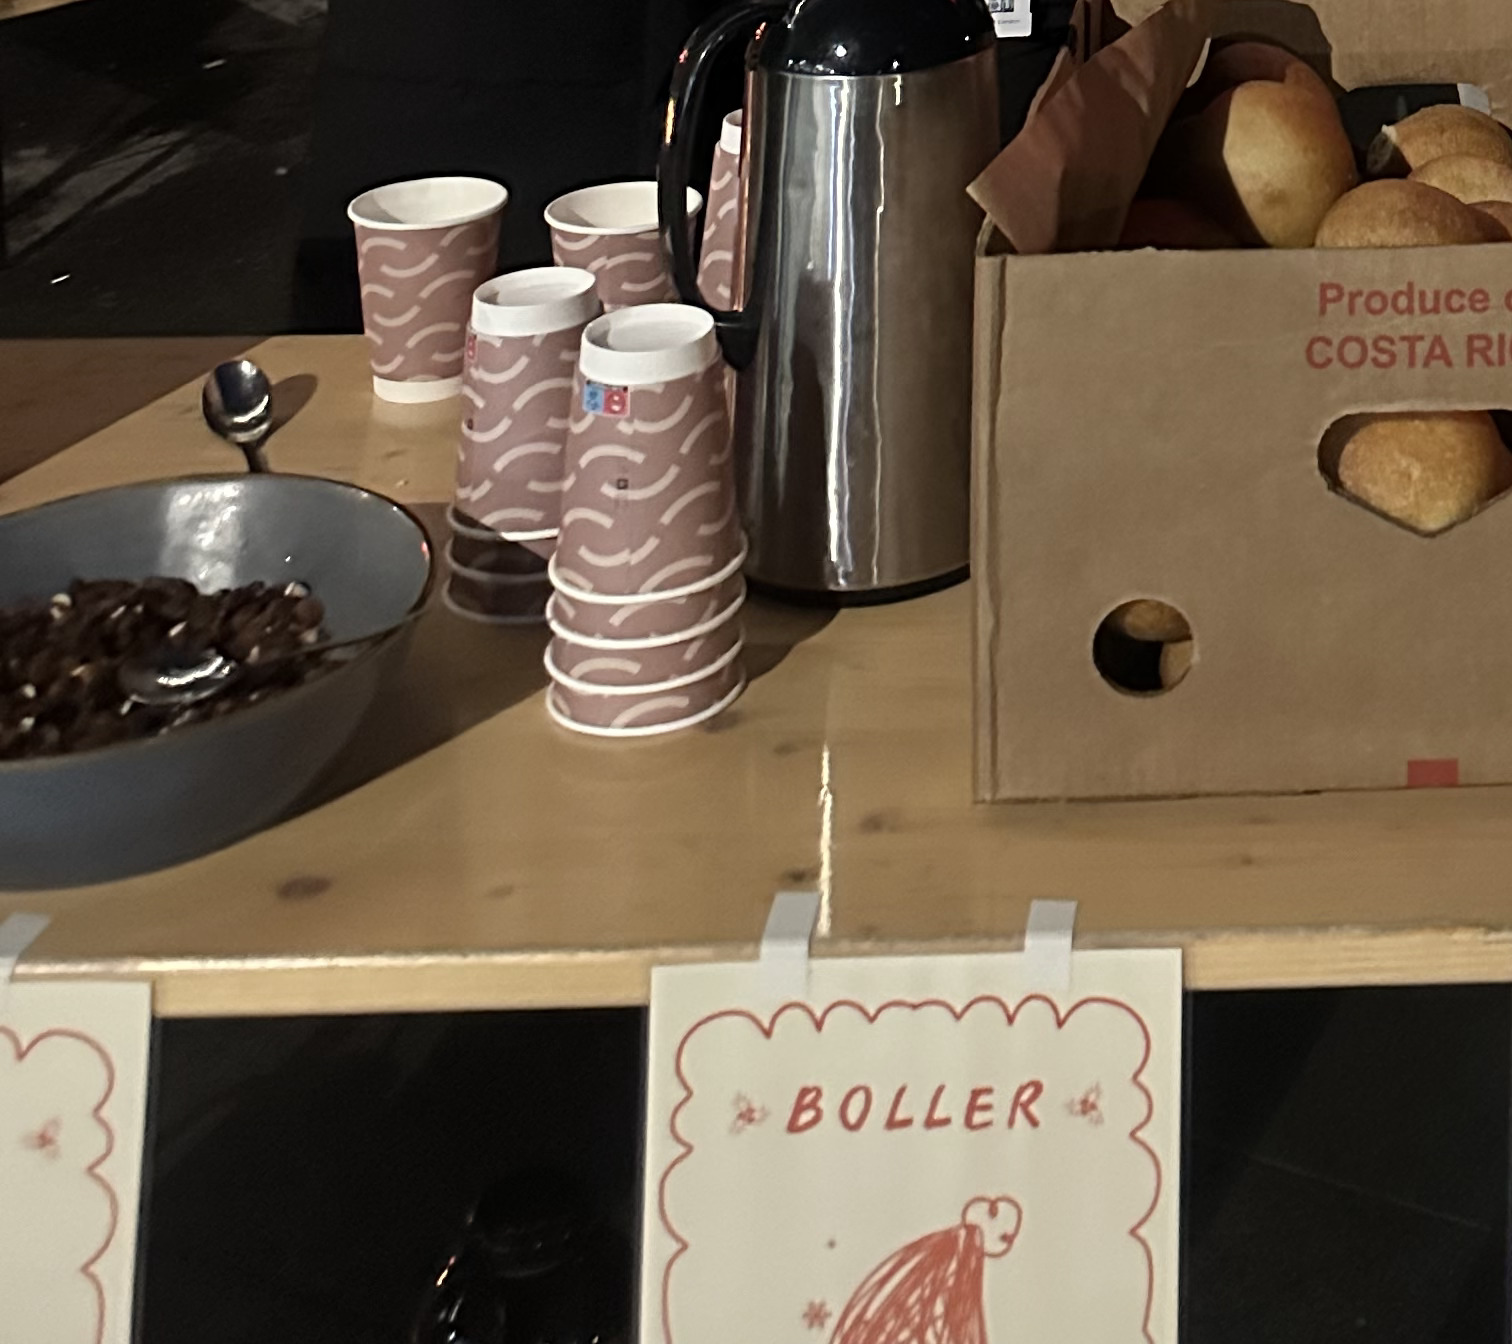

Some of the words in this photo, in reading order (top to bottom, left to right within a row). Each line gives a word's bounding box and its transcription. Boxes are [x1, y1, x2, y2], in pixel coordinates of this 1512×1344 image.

[1318, 280, 1490, 317] Produce
[1305, 334, 1453, 370] COSTA
[786, 1079, 1045, 1134] BOLLER
